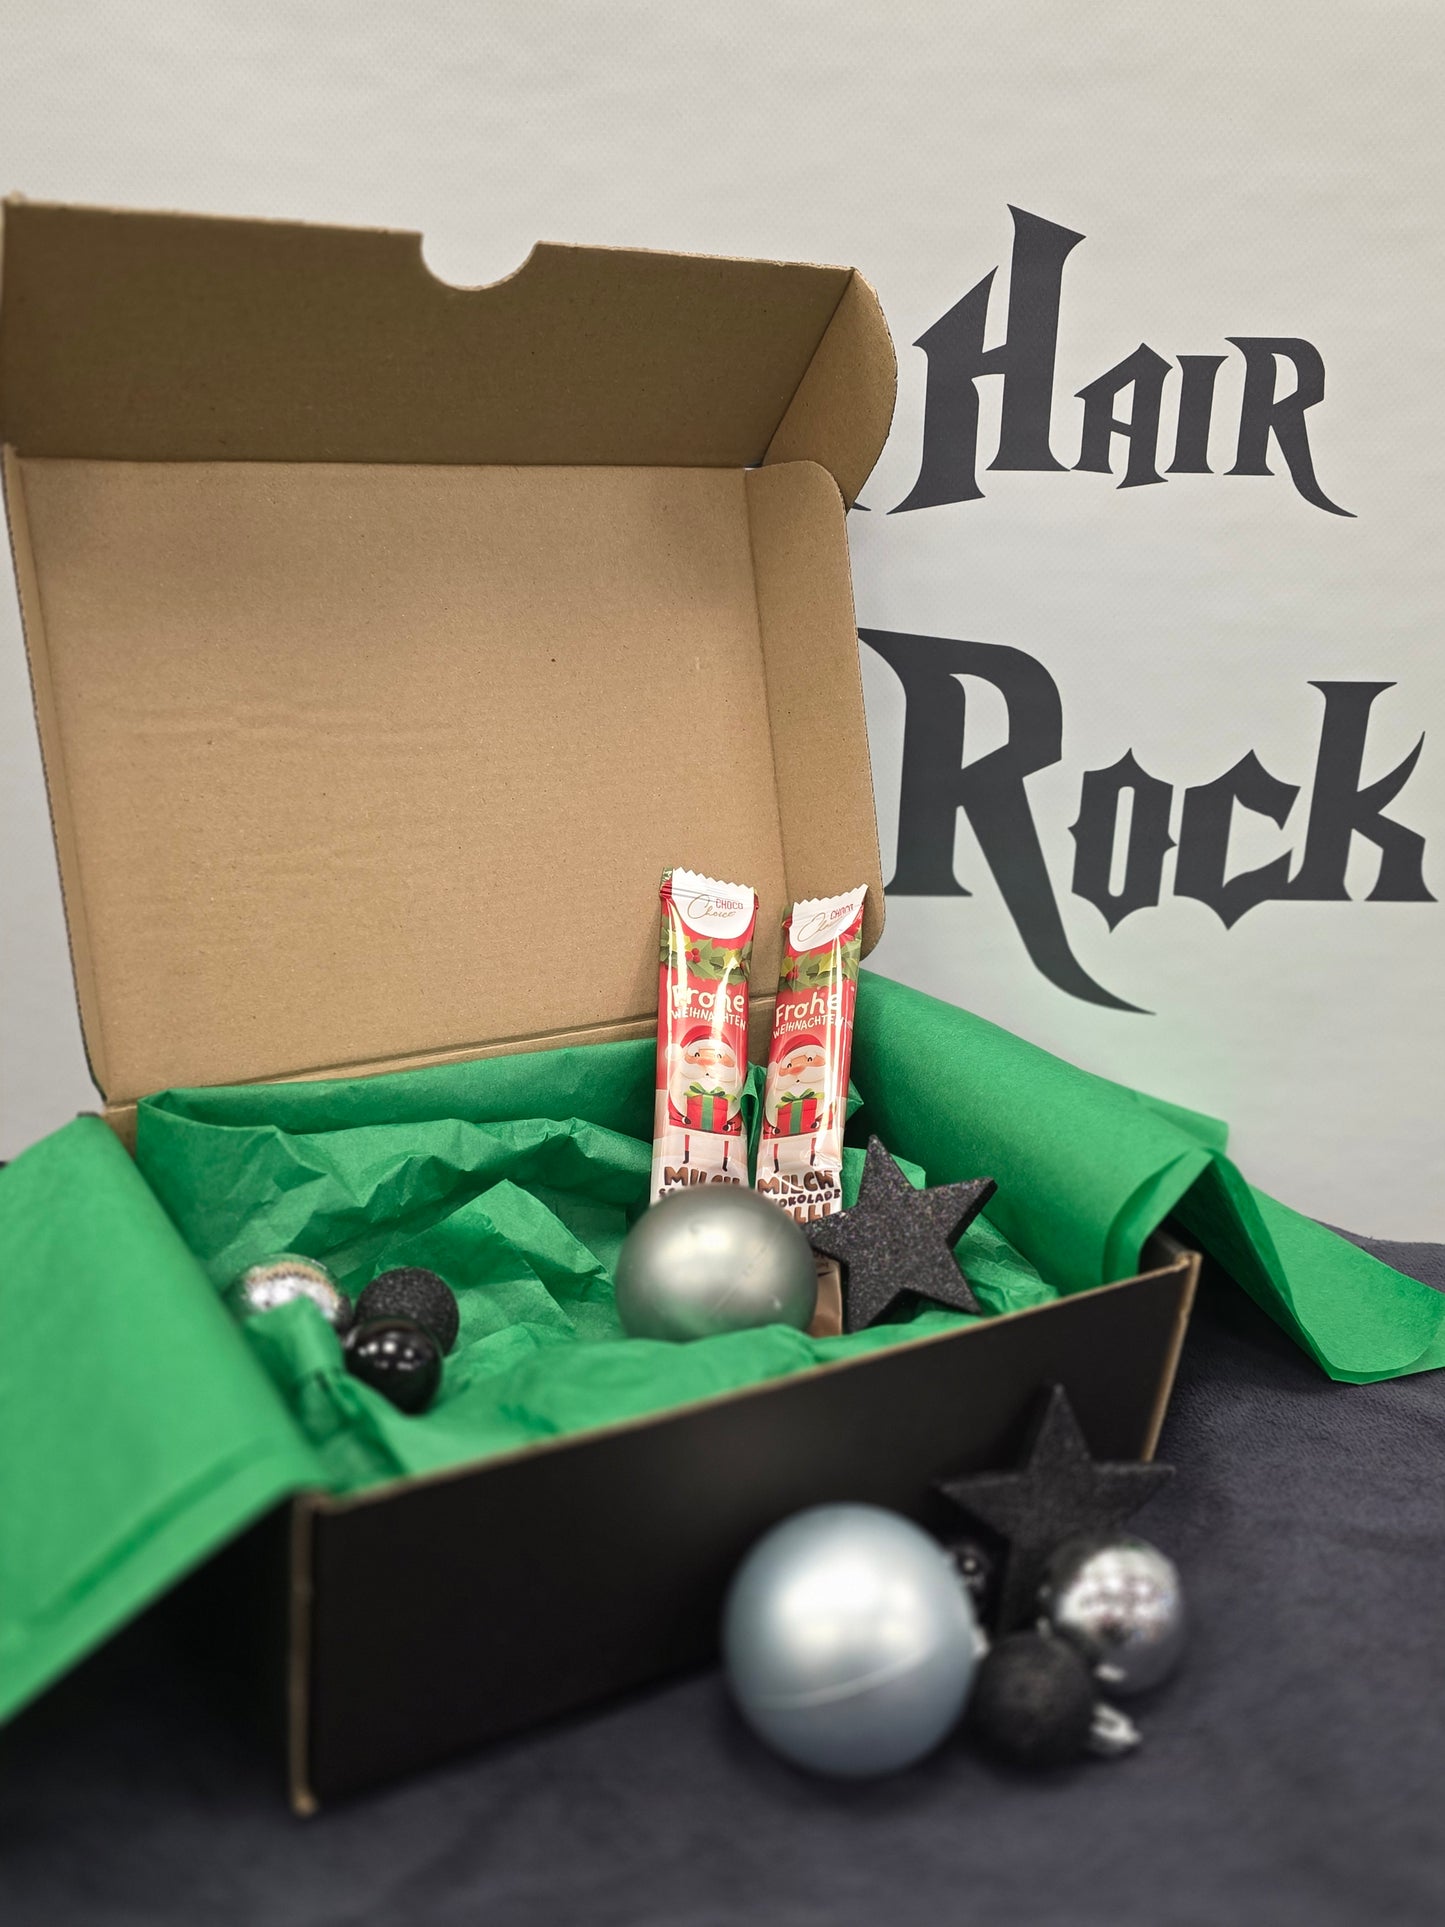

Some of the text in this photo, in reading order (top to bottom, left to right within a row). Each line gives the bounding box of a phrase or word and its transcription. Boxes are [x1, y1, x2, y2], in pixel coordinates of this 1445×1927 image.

[715, 898, 744, 910] CHOCO
[671, 1006, 746, 1031] WEIHNAHTEN
[775, 991, 840, 1028] Frohe
[757, 1169, 834, 1195] MILCH
